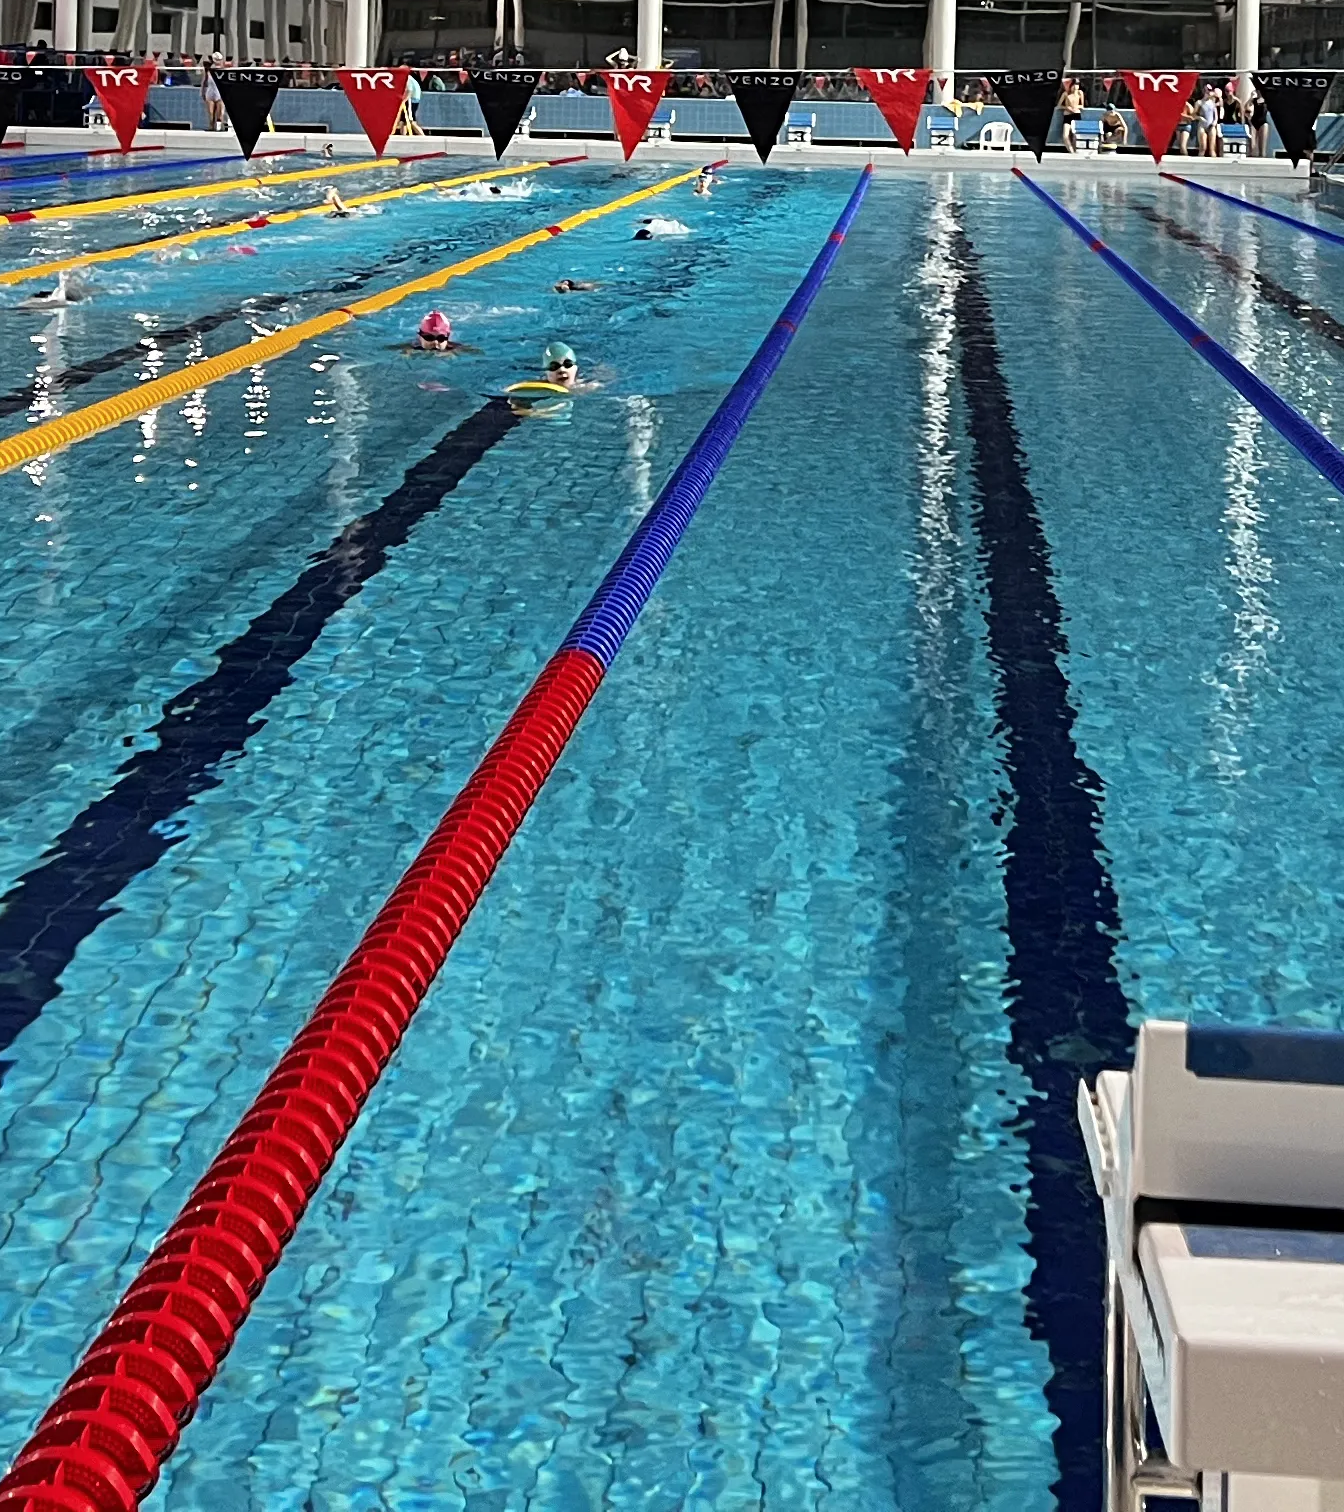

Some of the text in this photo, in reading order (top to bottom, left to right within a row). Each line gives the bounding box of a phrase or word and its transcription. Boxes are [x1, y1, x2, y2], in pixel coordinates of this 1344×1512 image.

[96, 69, 139, 86] TYR
[351, 72, 394, 90] TYR
[609, 73, 651, 93] TYR
[870, 68, 917, 84] TYR
[1133, 72, 1179, 92] TYR
